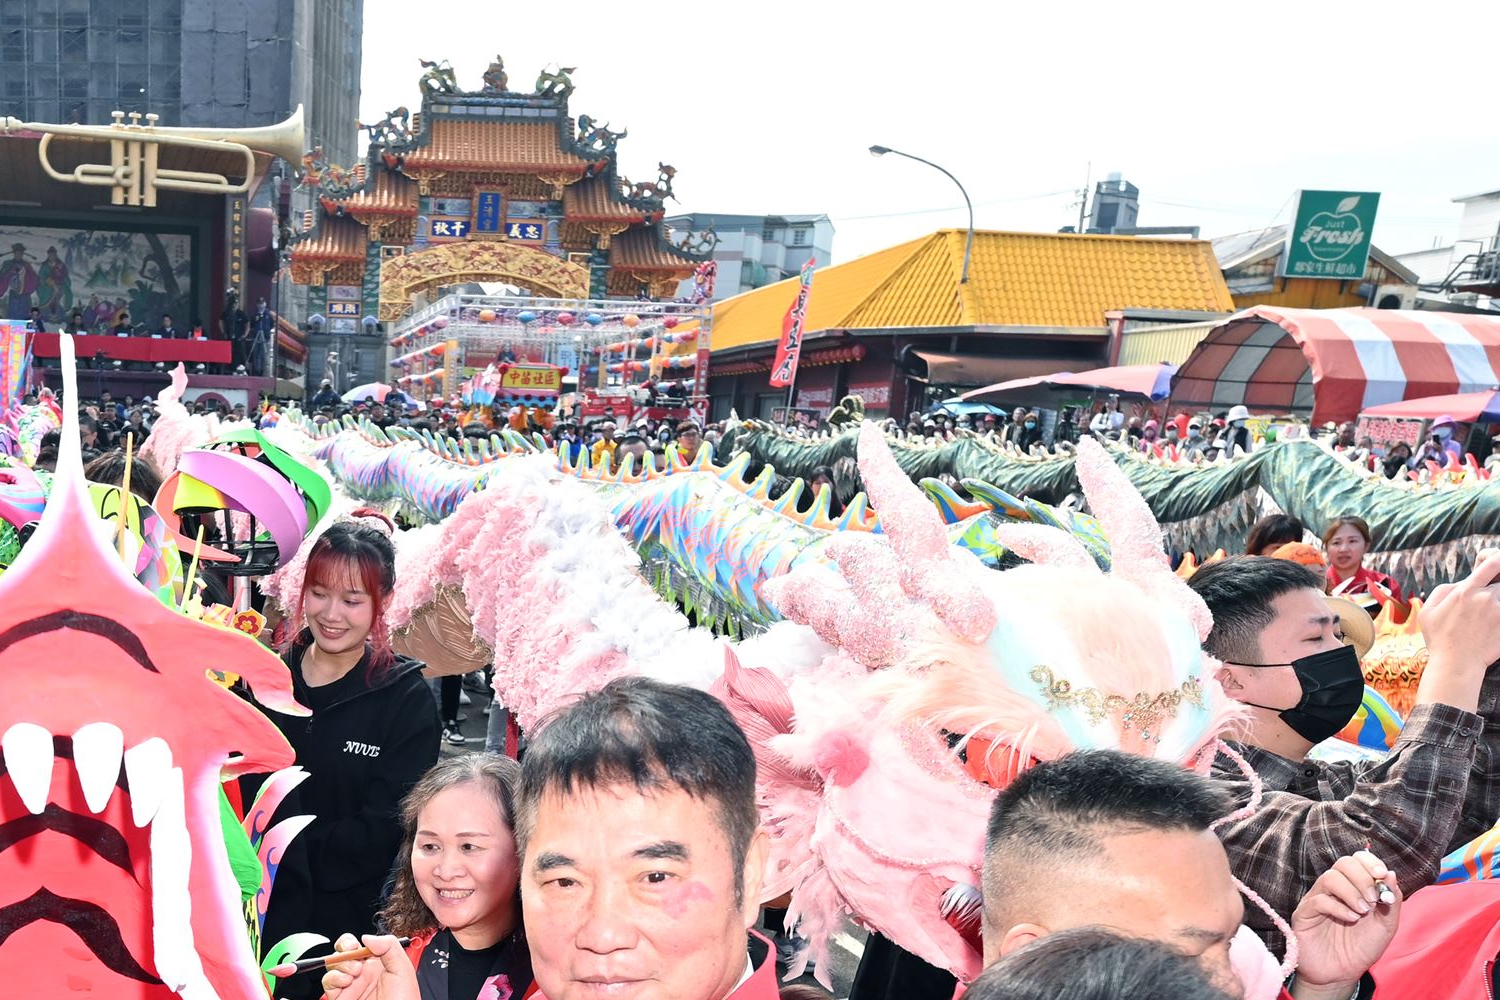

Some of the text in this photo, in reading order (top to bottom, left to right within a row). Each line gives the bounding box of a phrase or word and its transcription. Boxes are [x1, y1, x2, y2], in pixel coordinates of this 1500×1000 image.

[1300, 226, 1364, 245] Fresh
[509, 371, 555, 385] 中苗社區
